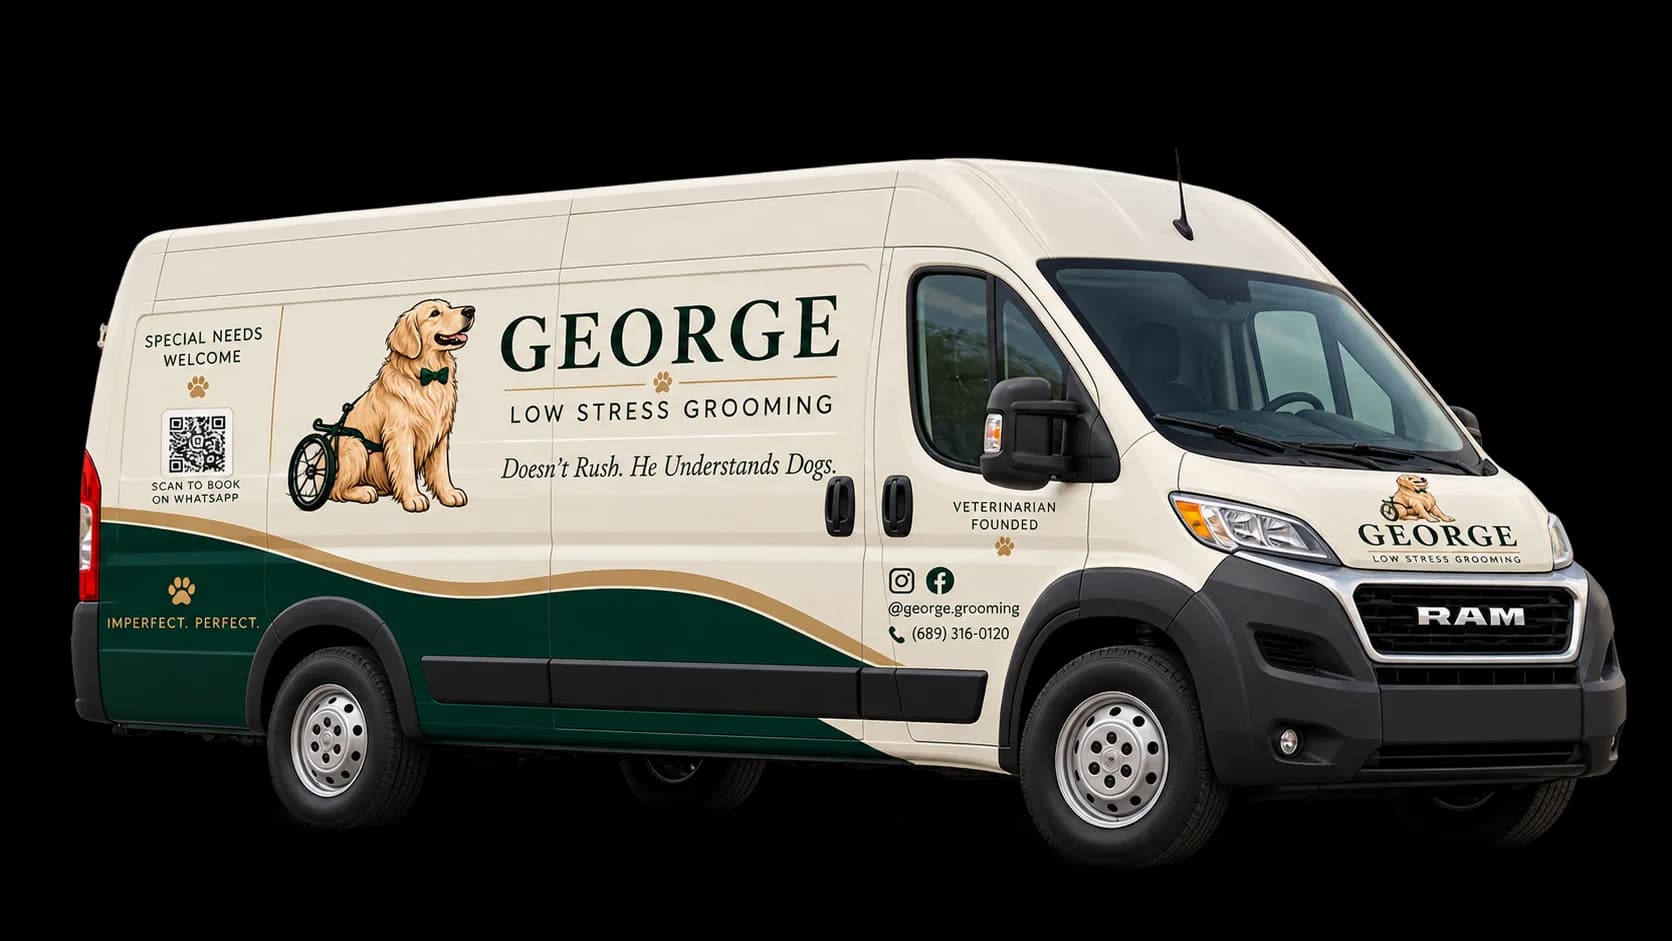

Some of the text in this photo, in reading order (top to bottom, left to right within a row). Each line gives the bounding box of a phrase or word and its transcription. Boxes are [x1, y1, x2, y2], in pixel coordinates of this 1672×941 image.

[145, 327, 262, 348] SPECIAL NEEDS
[500, 294, 840, 372] GEORGE
[163, 349, 242, 368] WELCOME
[511, 394, 833, 424] LOW STRESS GROOMING
[501, 453, 838, 481] Doesn't Rush. He Understands Dogs.
[151, 479, 241, 492] SCAN TO BOOK
[151, 493, 239, 505] ON WHATSAPP
[953, 501, 1056, 513] VETERINARIAN
[971, 518, 1039, 531] FOUNDED
[1358, 523, 1518, 547] GEORGE
[1372, 554, 1522, 564] LOW STRESS GROOMING
[888, 601, 1019, 617] @george.grooming
[1417, 607, 1525, 625] RAM
[106, 616, 260, 630] IMPERFECT. PERFECT.
[912, 626, 1009, 642] (689) 316-0120
